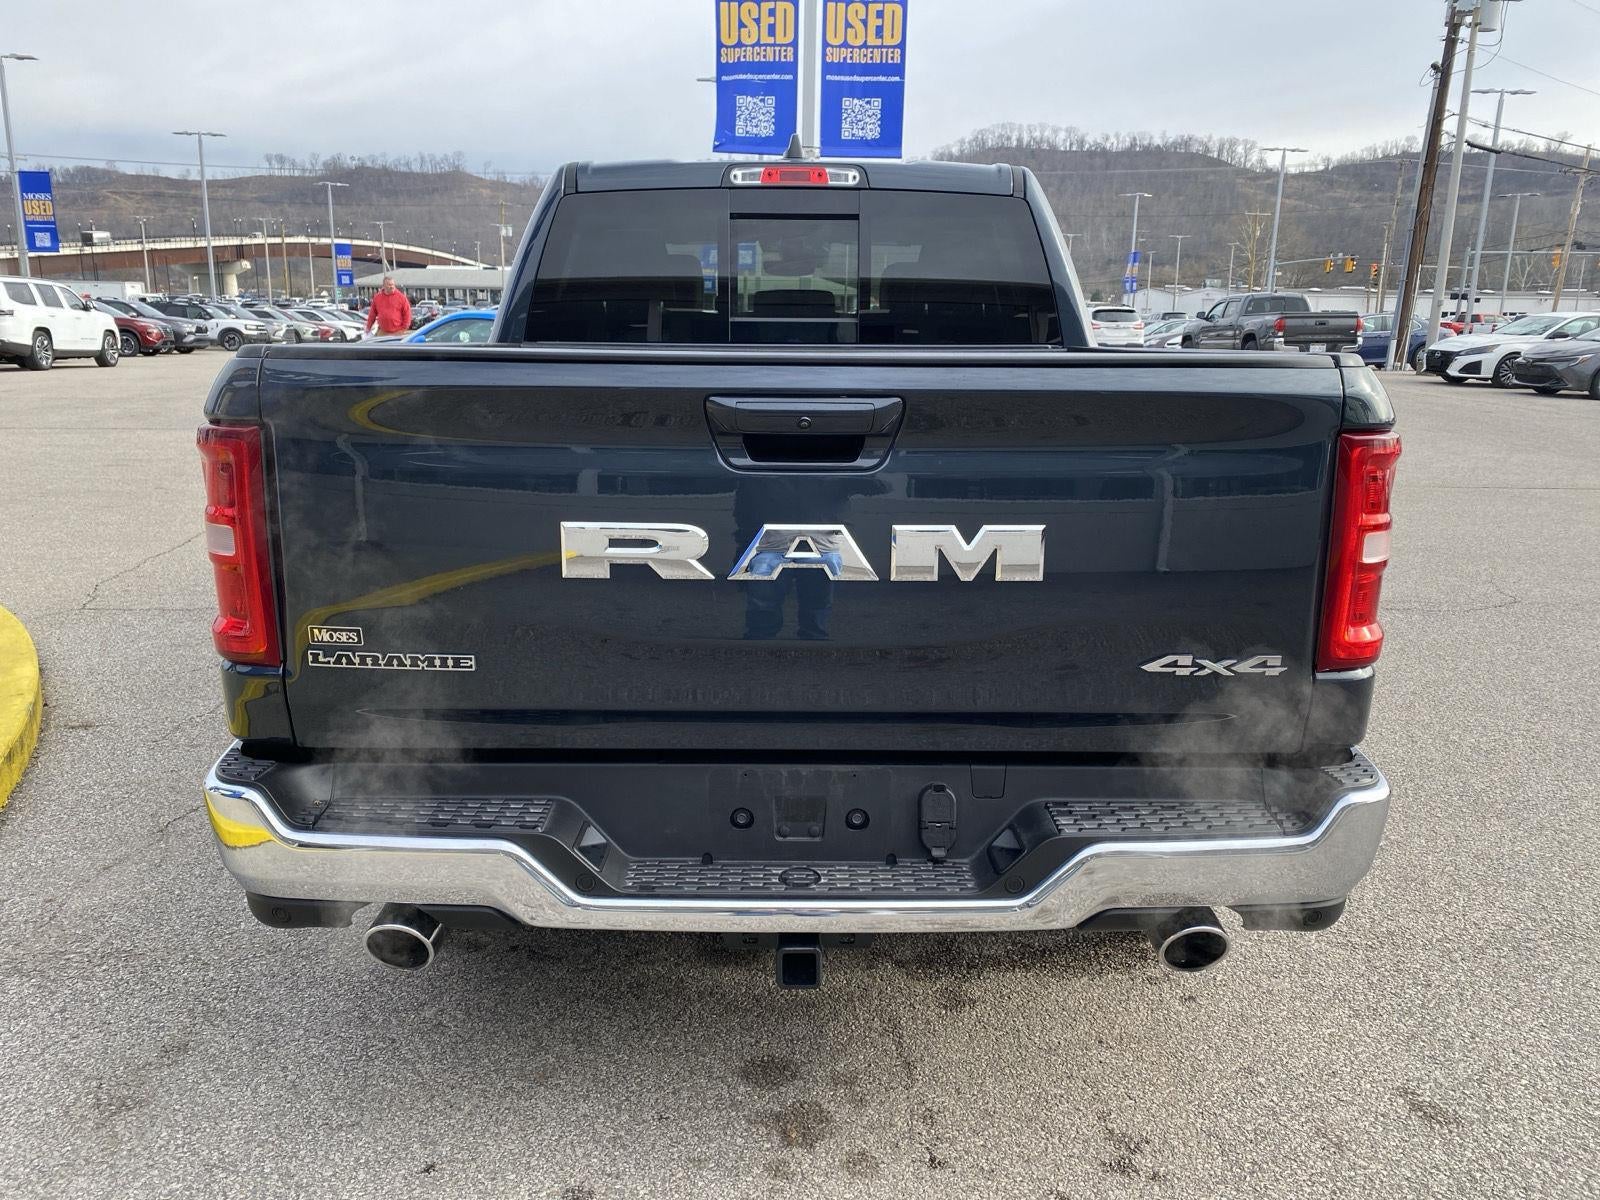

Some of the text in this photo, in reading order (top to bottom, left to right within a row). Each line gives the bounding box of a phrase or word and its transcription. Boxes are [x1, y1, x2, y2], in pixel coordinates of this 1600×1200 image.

[720, 2, 795, 46] USED
[825, 2, 903, 47] USED
[720, 47, 794, 63] SUPERCENTER
[826, 48, 901, 64] SUPERCENTER
[22, 192, 52, 201] MOSES
[23, 200, 54, 216] USED
[560, 521, 1047, 583] RAM
[307, 650, 476, 672] LARAMIE
[1140, 654, 1288, 677] 4x4
